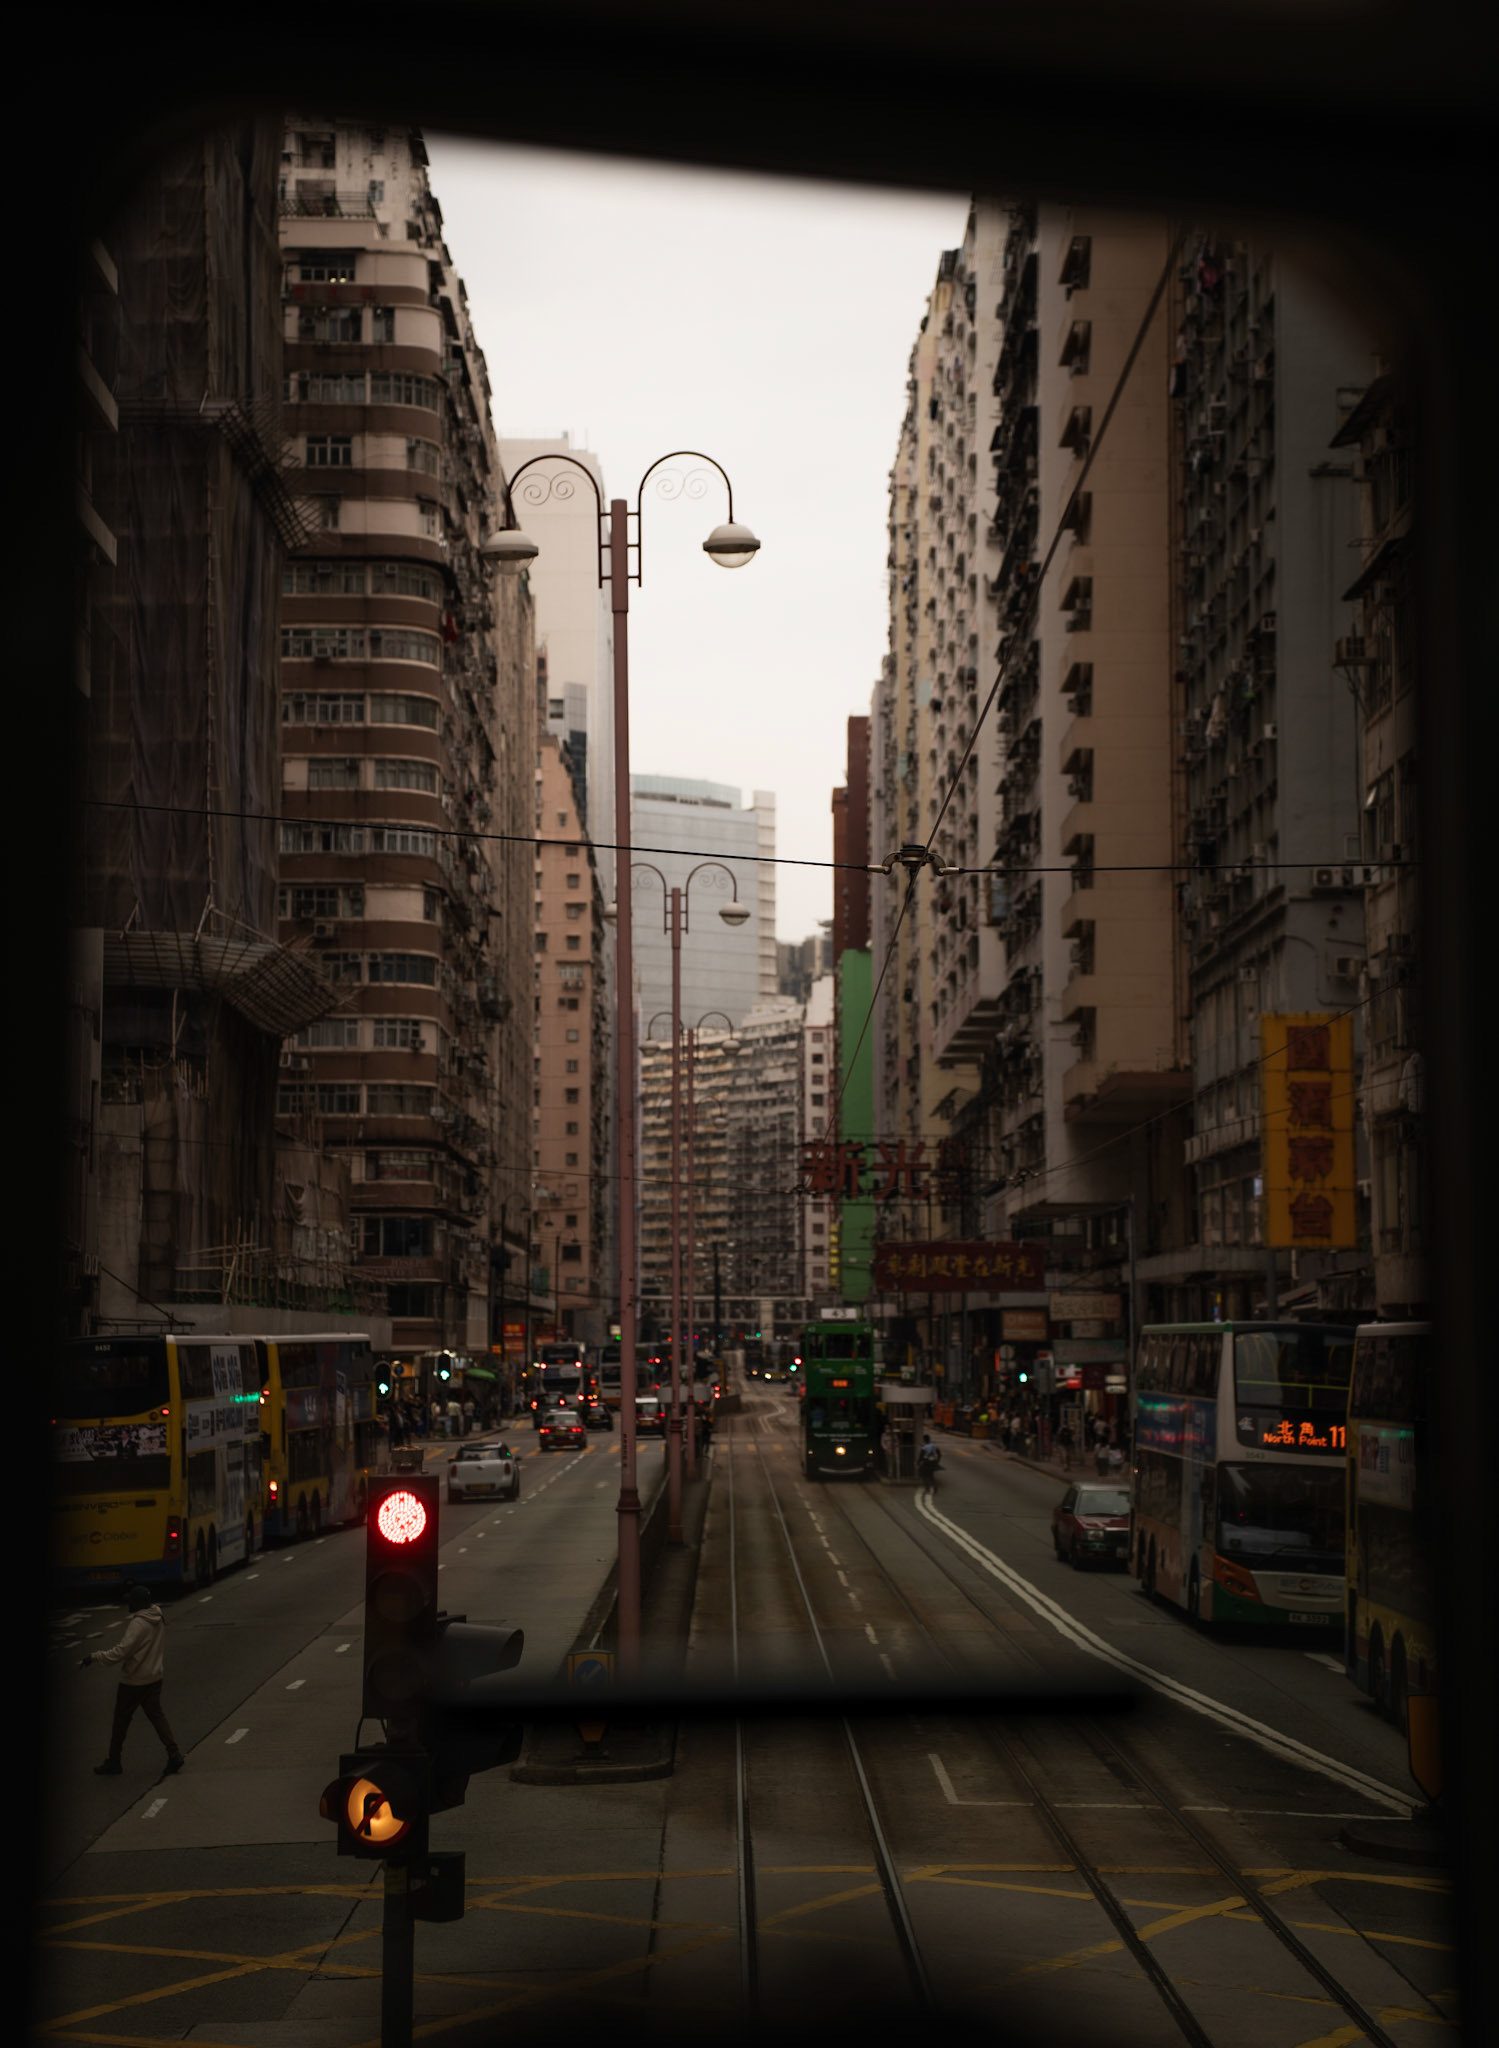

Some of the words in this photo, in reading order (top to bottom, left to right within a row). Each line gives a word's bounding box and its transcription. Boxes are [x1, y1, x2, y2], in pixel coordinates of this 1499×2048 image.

[800, 1138, 931, 1200] 新光
[1277, 1419, 1316, 1437] 北角
[1262, 1432, 1296, 1445] North
[1298, 1435, 1328, 1448] Point
